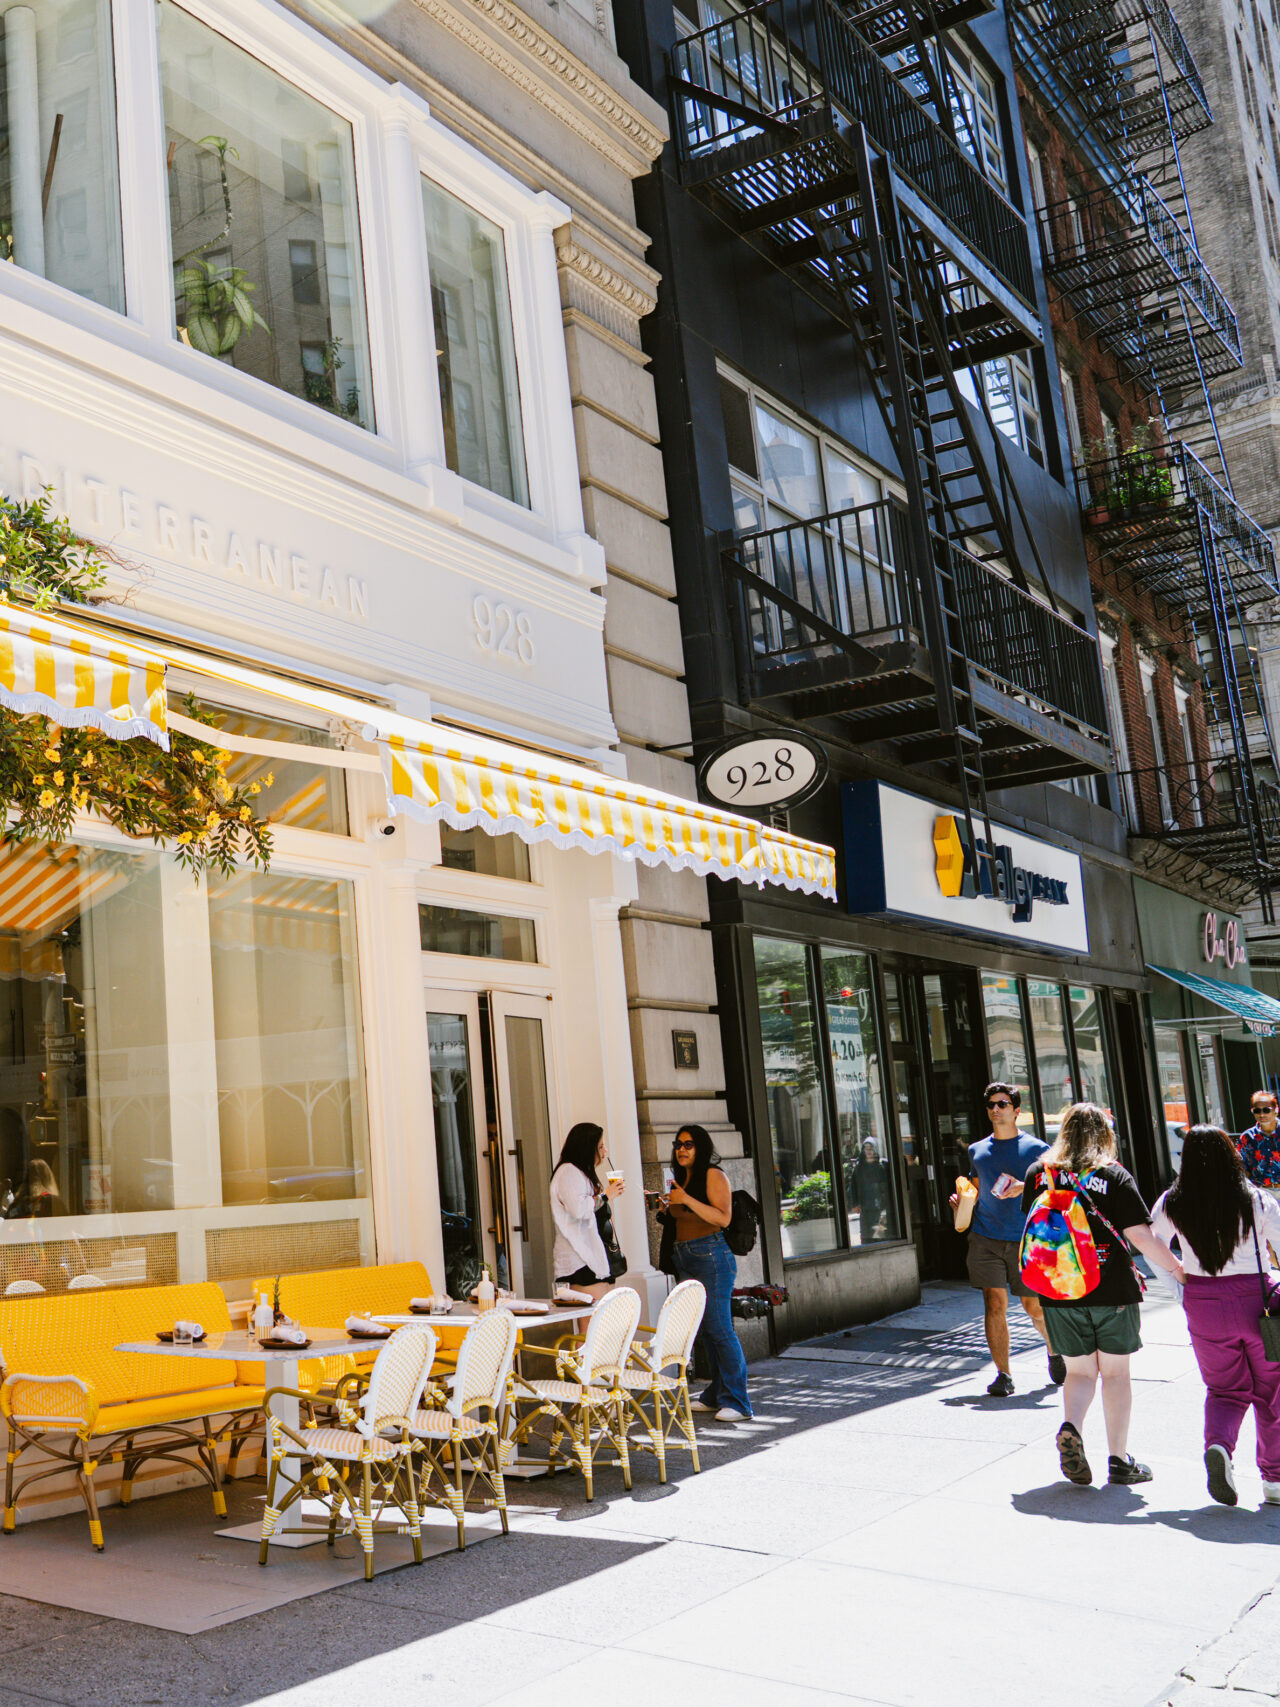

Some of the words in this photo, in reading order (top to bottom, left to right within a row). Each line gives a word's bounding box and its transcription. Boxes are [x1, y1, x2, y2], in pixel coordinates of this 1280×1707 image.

[473, 594, 537, 666] 928
[727, 747, 794, 799] 928
[1204, 911, 1225, 963] Cha
[1226, 920, 1247, 969] Cha
